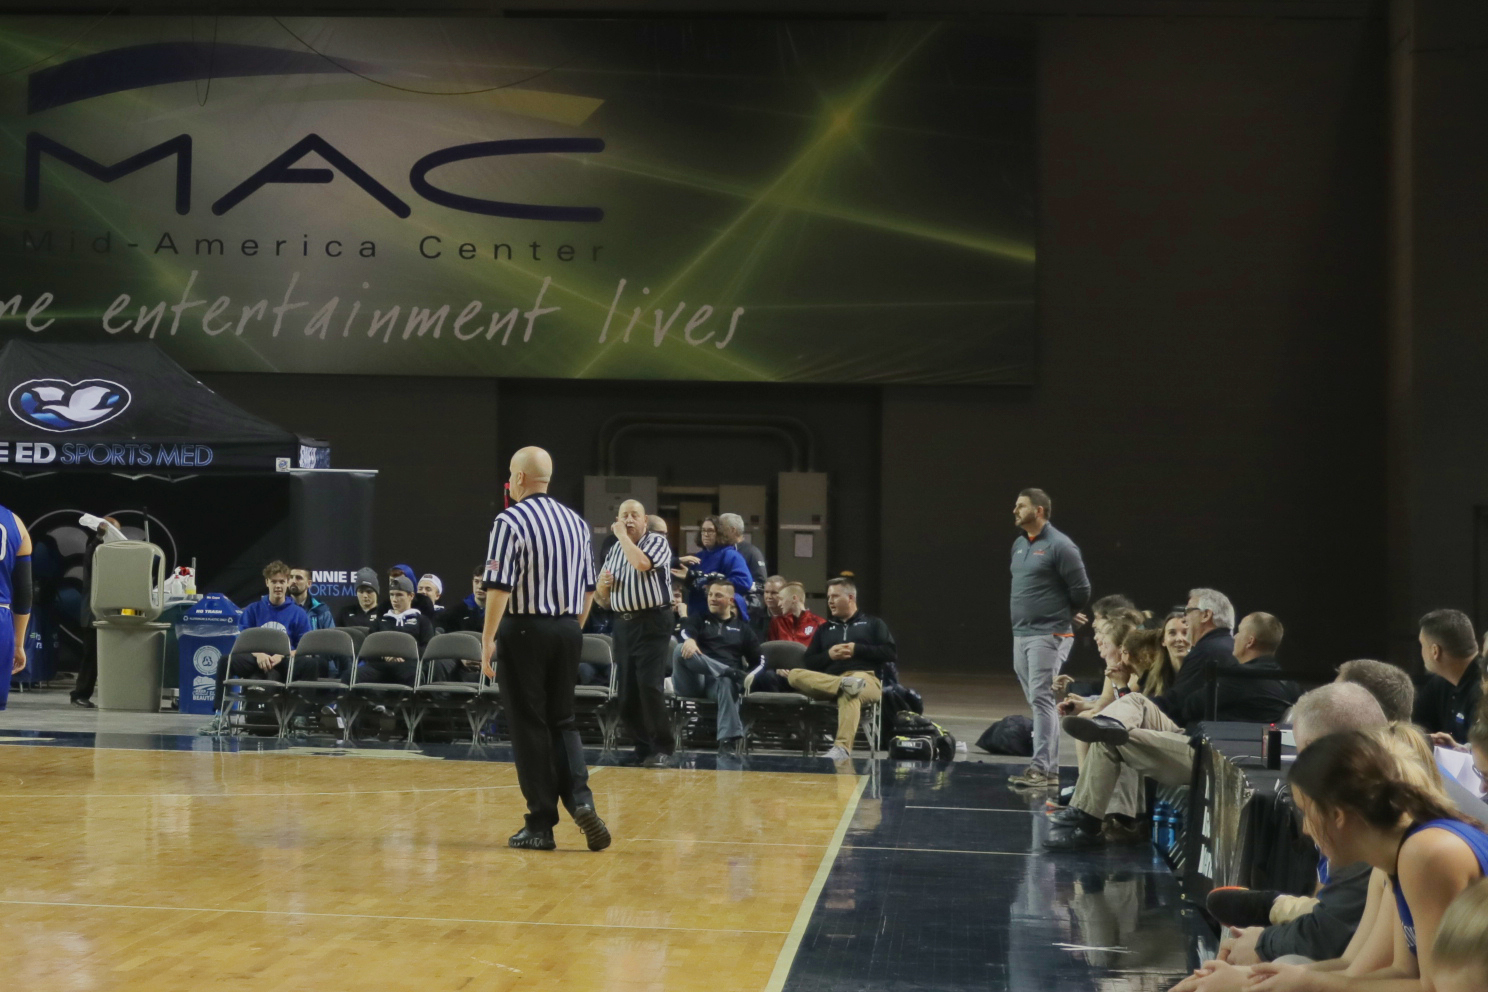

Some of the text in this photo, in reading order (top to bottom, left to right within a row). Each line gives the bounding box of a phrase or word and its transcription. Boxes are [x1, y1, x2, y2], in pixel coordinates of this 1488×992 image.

[25, 130, 606, 222] MAC
[21, 229, 606, 264] Mid-America Center
[102, 270, 561, 346] entertainment
[598, 277, 745, 350] lives
[15, 442, 56, 464] ED
[59, 443, 153, 466] SPORTS
[155, 444, 213, 467] MED
